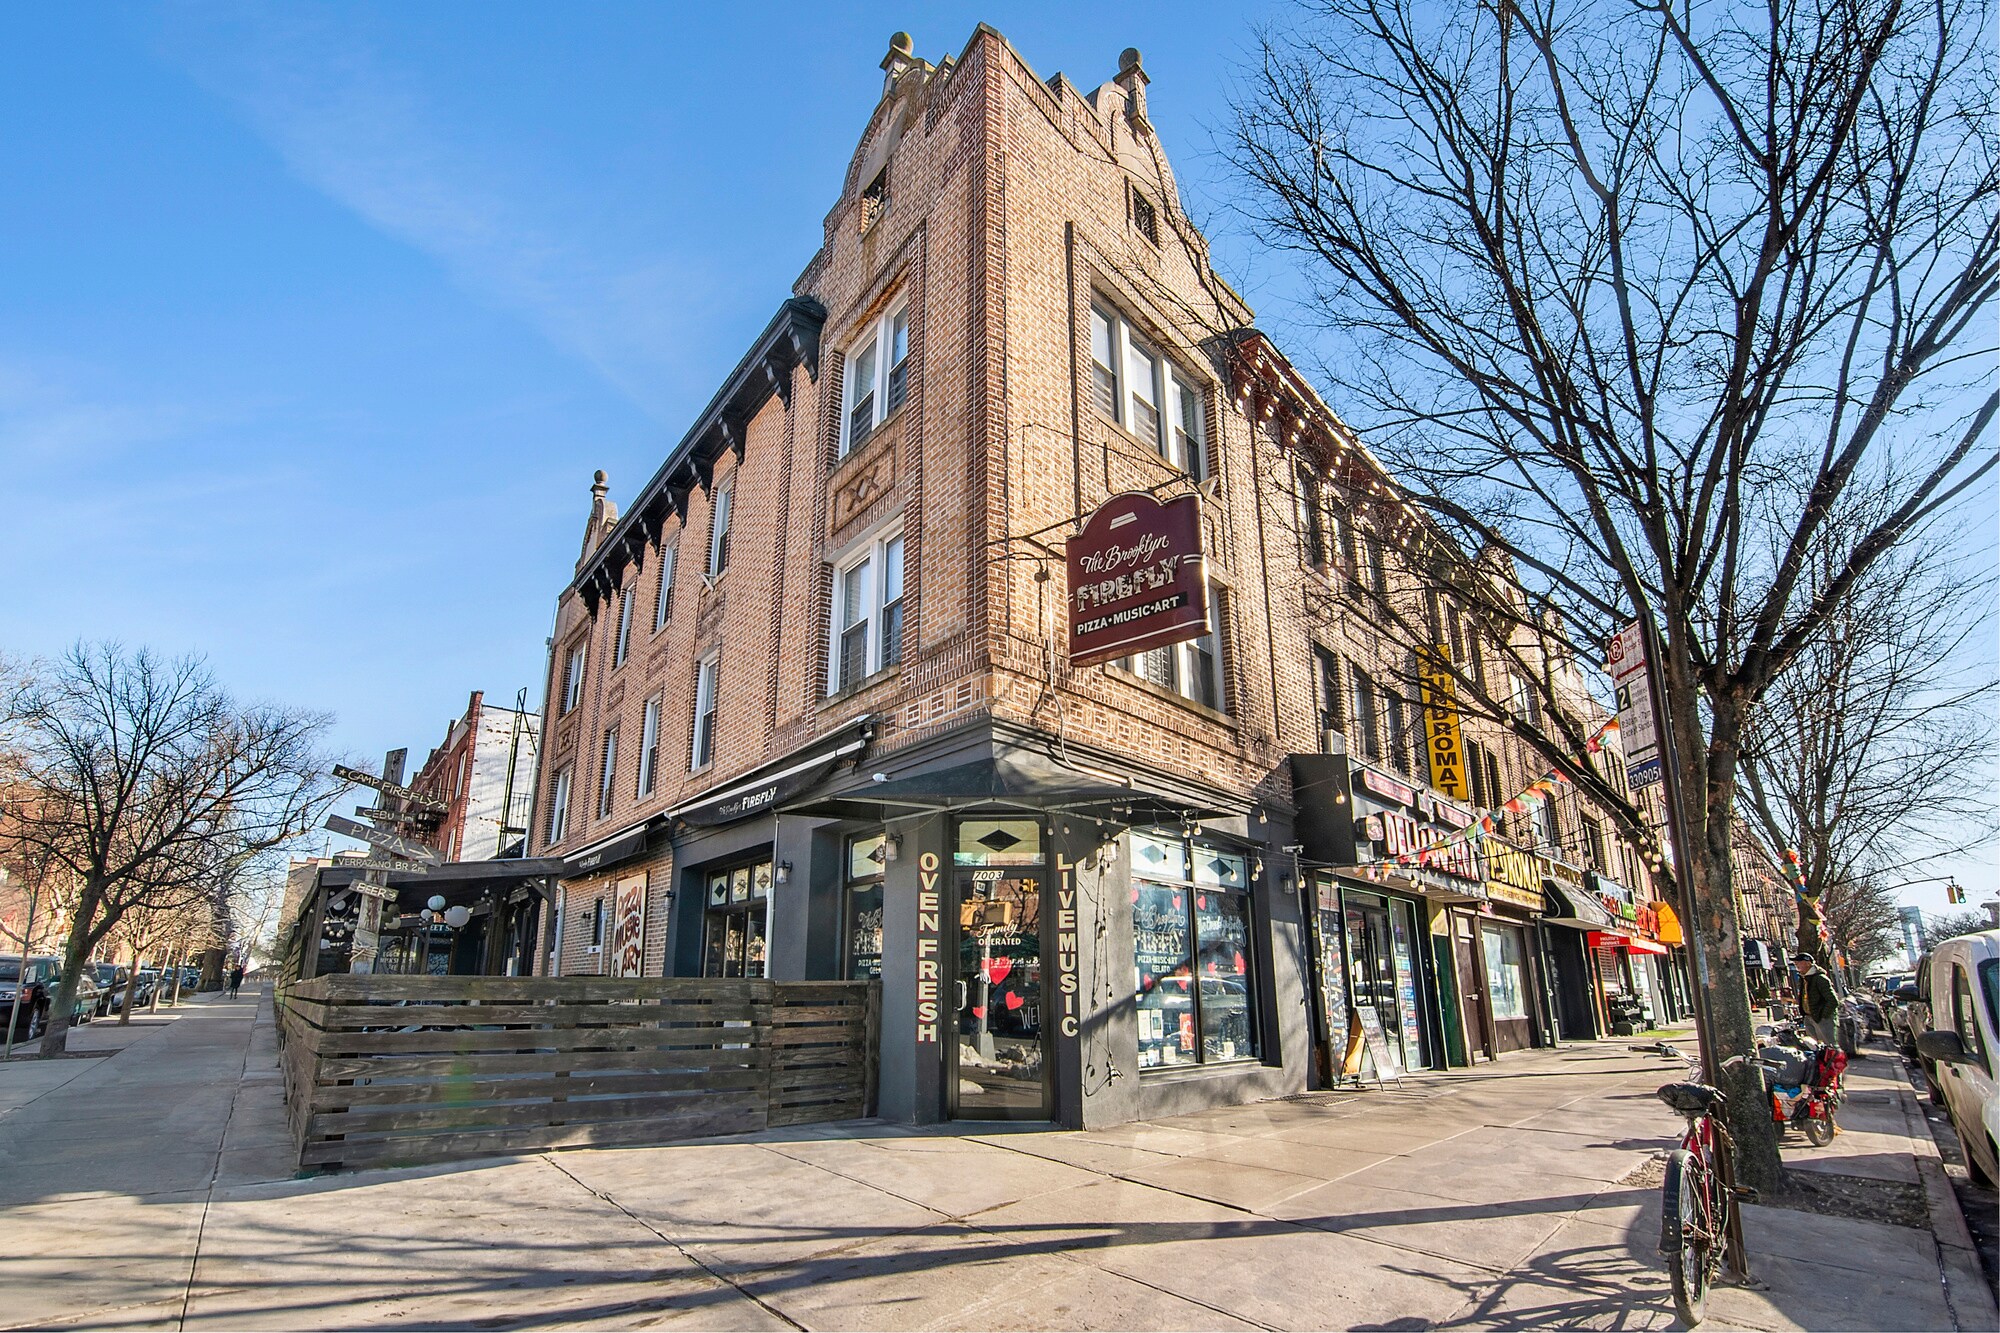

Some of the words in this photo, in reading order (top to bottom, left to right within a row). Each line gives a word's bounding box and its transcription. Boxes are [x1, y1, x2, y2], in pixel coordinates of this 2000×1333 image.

[1080, 551, 1104, 574] The
[1102, 533, 1169, 572] Brooklyn
[1077, 555, 1179, 613] FIREFLY
[1619, 688, 1628, 710] 2
[1424, 650, 1459, 797] AUNDROMAT
[348, 770, 380, 786] CAMP
[381, 782, 438, 807] FIREFLY
[742, 787, 777, 811] FIREFLY
[362, 809, 395, 820] CEBU
[351, 825, 405, 853] PIZZA
[338, 858, 391, 869] VERRAZANO
[395, 862, 408, 871] BR
[974, 872, 1002, 880] 7003
[357, 883, 386, 898] BEER
[919, 852, 939, 932] OVEN
[1057, 853, 1076, 929] LIVE
[977, 920, 1022, 938] Family
[1152, 965, 1170, 973] GELATO
[918, 939, 939, 1042] FRESH
[1058, 933, 1079, 1037] MUSIC
